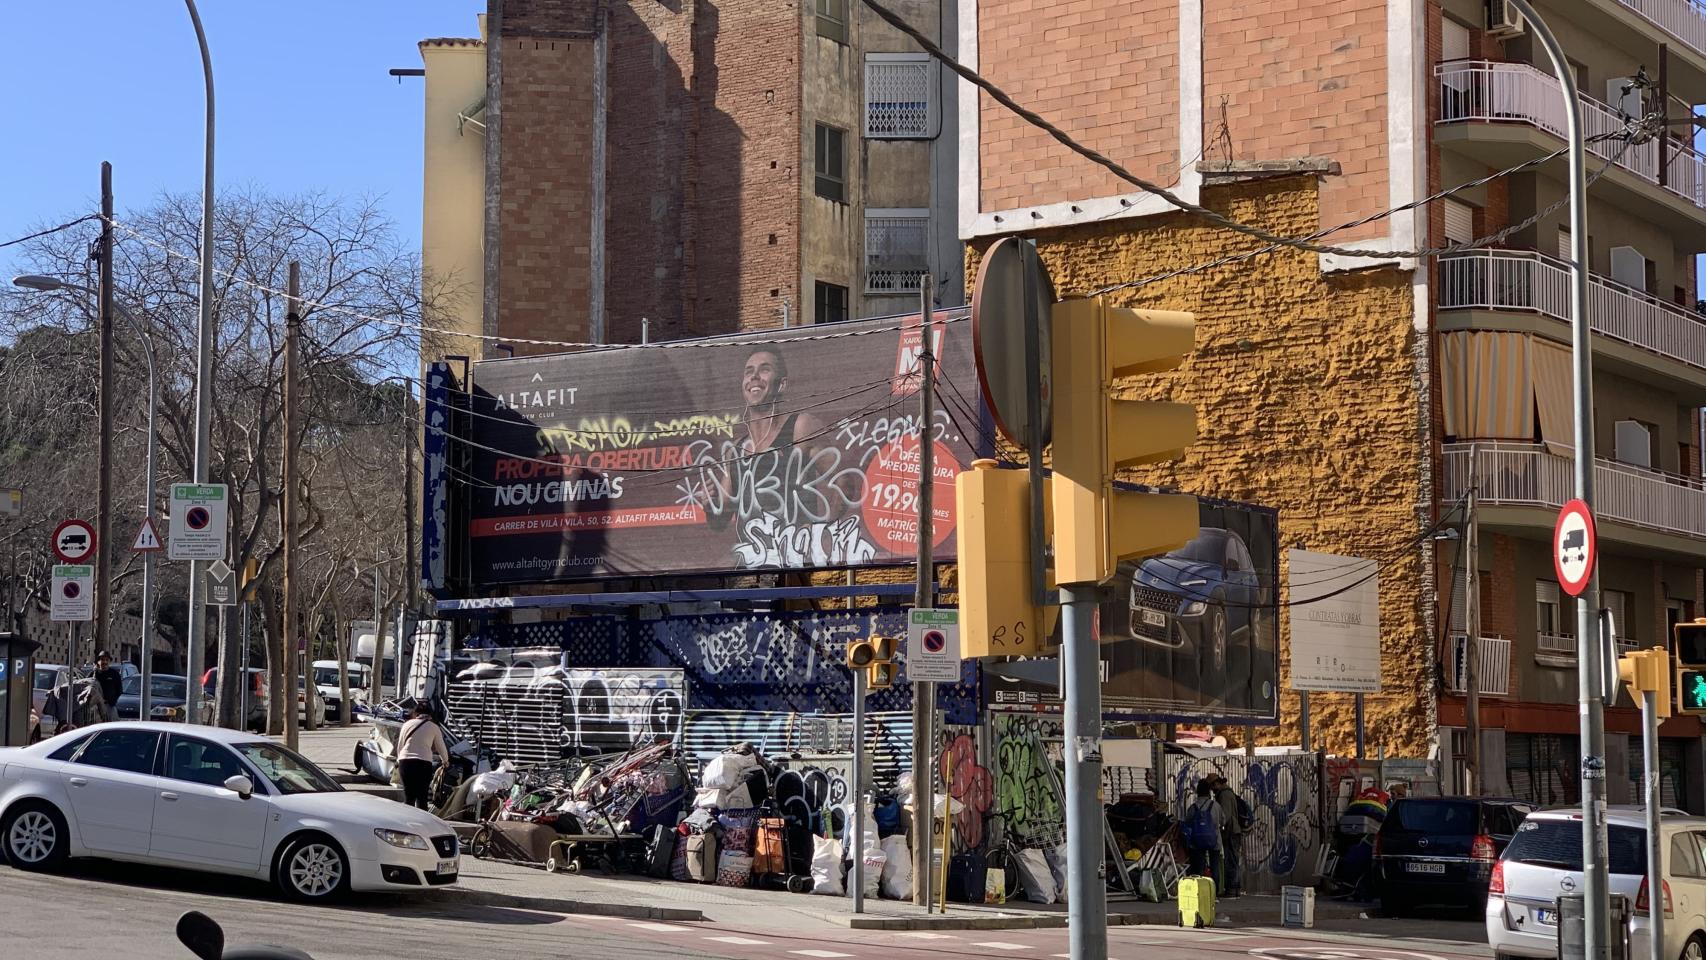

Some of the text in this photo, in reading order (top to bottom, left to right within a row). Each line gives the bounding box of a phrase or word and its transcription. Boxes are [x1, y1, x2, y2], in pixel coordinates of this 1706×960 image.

[903, 336, 922, 345] XARX
[494, 387, 578, 411] ALTAFIT
[495, 444, 695, 481] PROPERA OBERTURA
[899, 450, 938, 465] OFEA
[880, 459, 954, 479] PREOBEURA
[494, 472, 624, 506] NOU GIMNÀS
[903, 480, 916, 488] DES
[494, 522, 525, 531] CARRER
[527, 520, 539, 529] DE
[615, 513, 647, 524] ALTAFIT
[877, 517, 936, 535] MATRÍCA
[887, 530, 918, 543] GRATI
[492, 554, 604, 571] www.altafitgymclub.com
[15, 659, 24, 675] P
